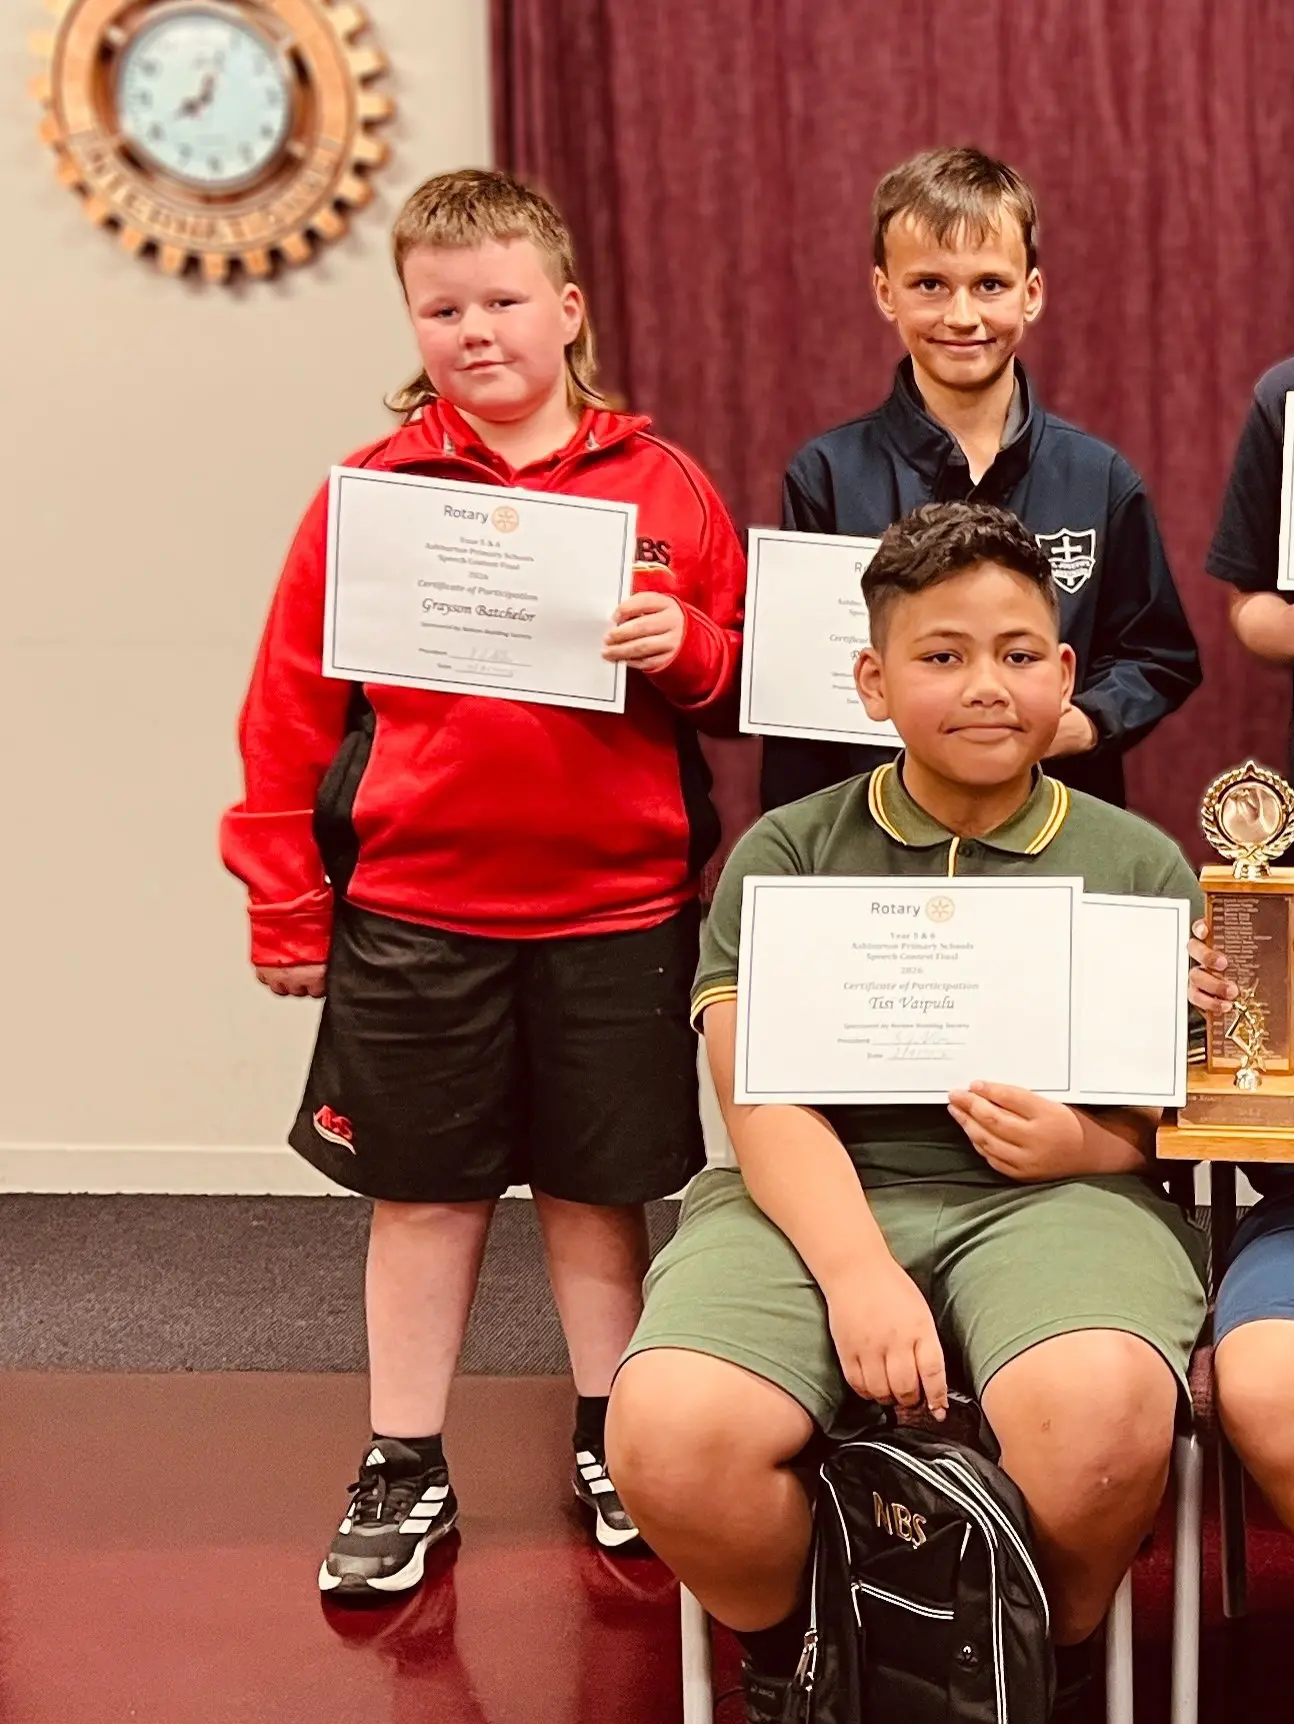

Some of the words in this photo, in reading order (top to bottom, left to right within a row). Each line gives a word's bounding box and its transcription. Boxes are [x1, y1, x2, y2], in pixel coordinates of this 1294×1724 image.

[444, 505, 489, 523] Rotary
[635, 536, 671, 567] BS
[422, 598, 472, 617] Grayson
[871, 902, 921, 917] Rotary
[844, 982, 895, 992] Certificate
[898, 982, 909, 991] of
[911, 982, 979, 992] Participation
[872, 1491, 927, 1549] NBS
